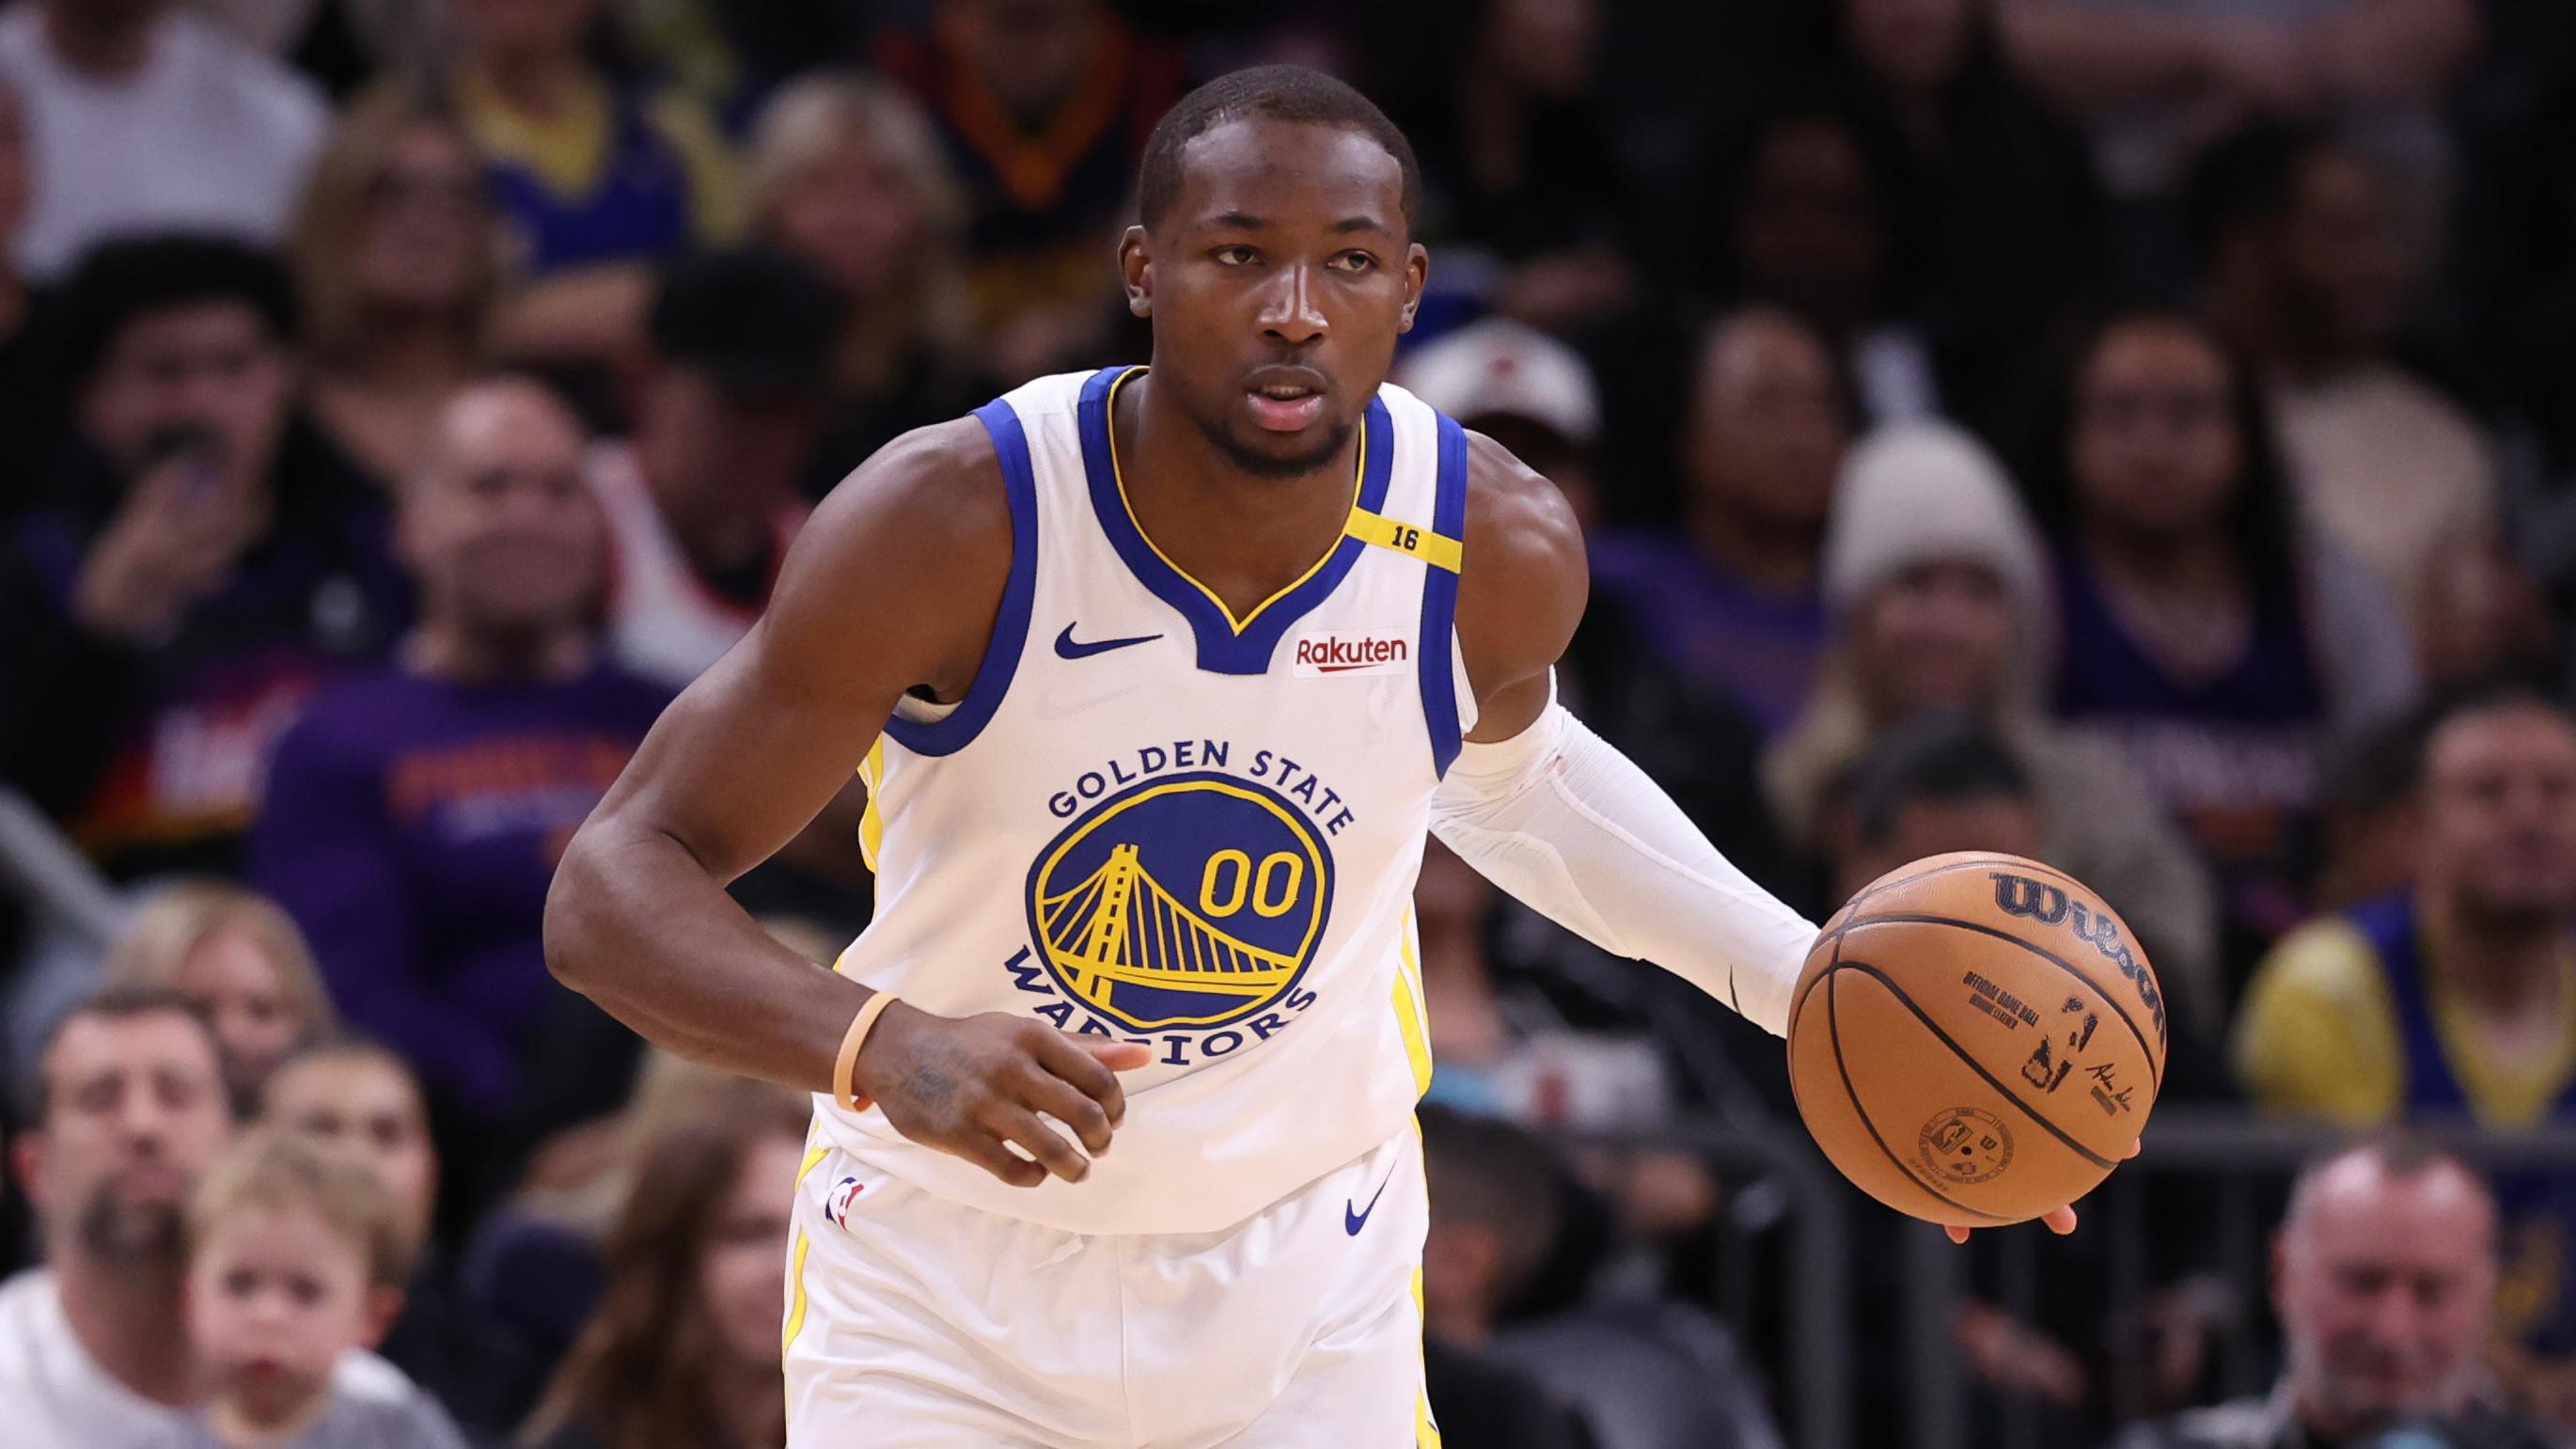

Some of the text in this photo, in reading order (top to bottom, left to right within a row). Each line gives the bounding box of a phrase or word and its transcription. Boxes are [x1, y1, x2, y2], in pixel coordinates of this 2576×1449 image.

[1391, 525, 1420, 551] 16
[1296, 636, 1407, 665] Rakuten
[1047, 739, 1356, 837] GOLDEN STATE
[1198, 848, 1305, 919] 00
[1988, 872, 2167, 1055] Wilson
[1003, 943, 1318, 1066] WARIORS
[1996, 990, 2023, 1016] GAME
[2018, 1004, 2040, 1028] BALL
